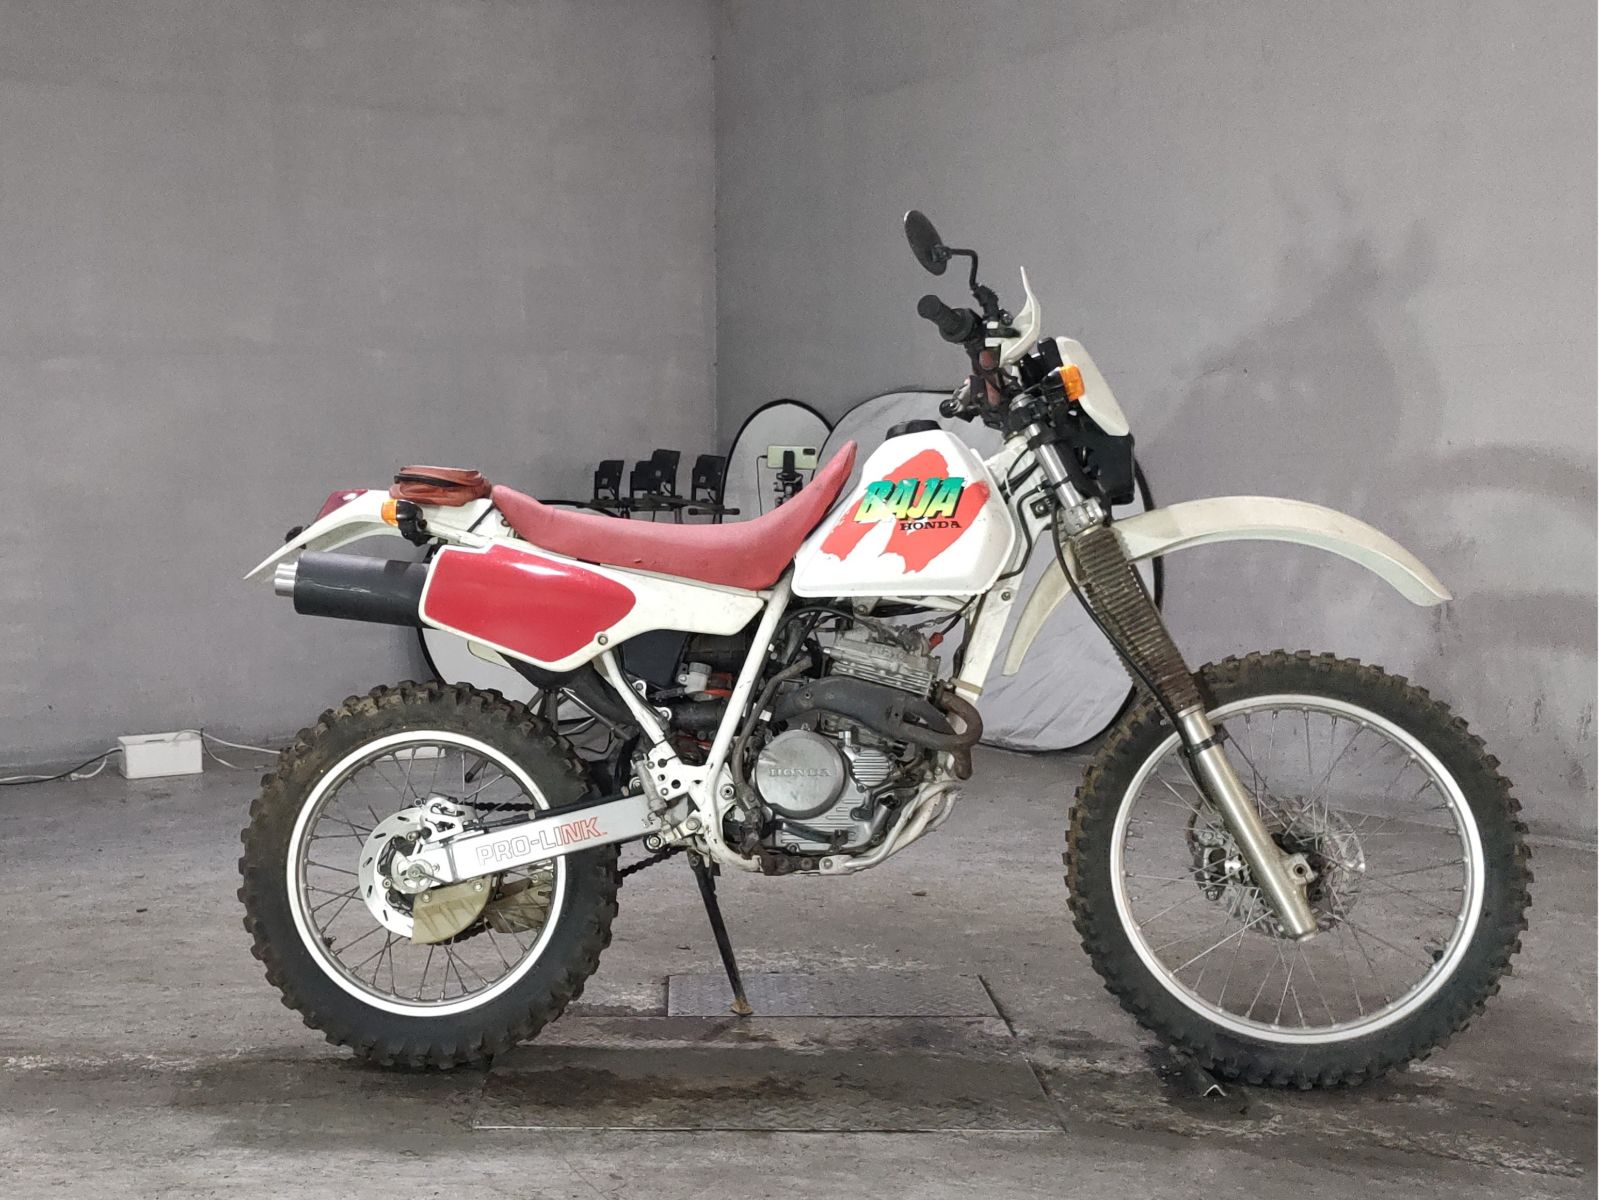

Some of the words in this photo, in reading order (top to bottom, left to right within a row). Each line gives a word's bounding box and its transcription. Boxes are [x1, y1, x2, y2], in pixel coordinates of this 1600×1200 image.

[854, 477, 965, 522] BAJA
[900, 520, 962, 531] HONDA
[769, 767, 832, 777] HONDA
[475, 816, 603, 865] PRO-LINK
